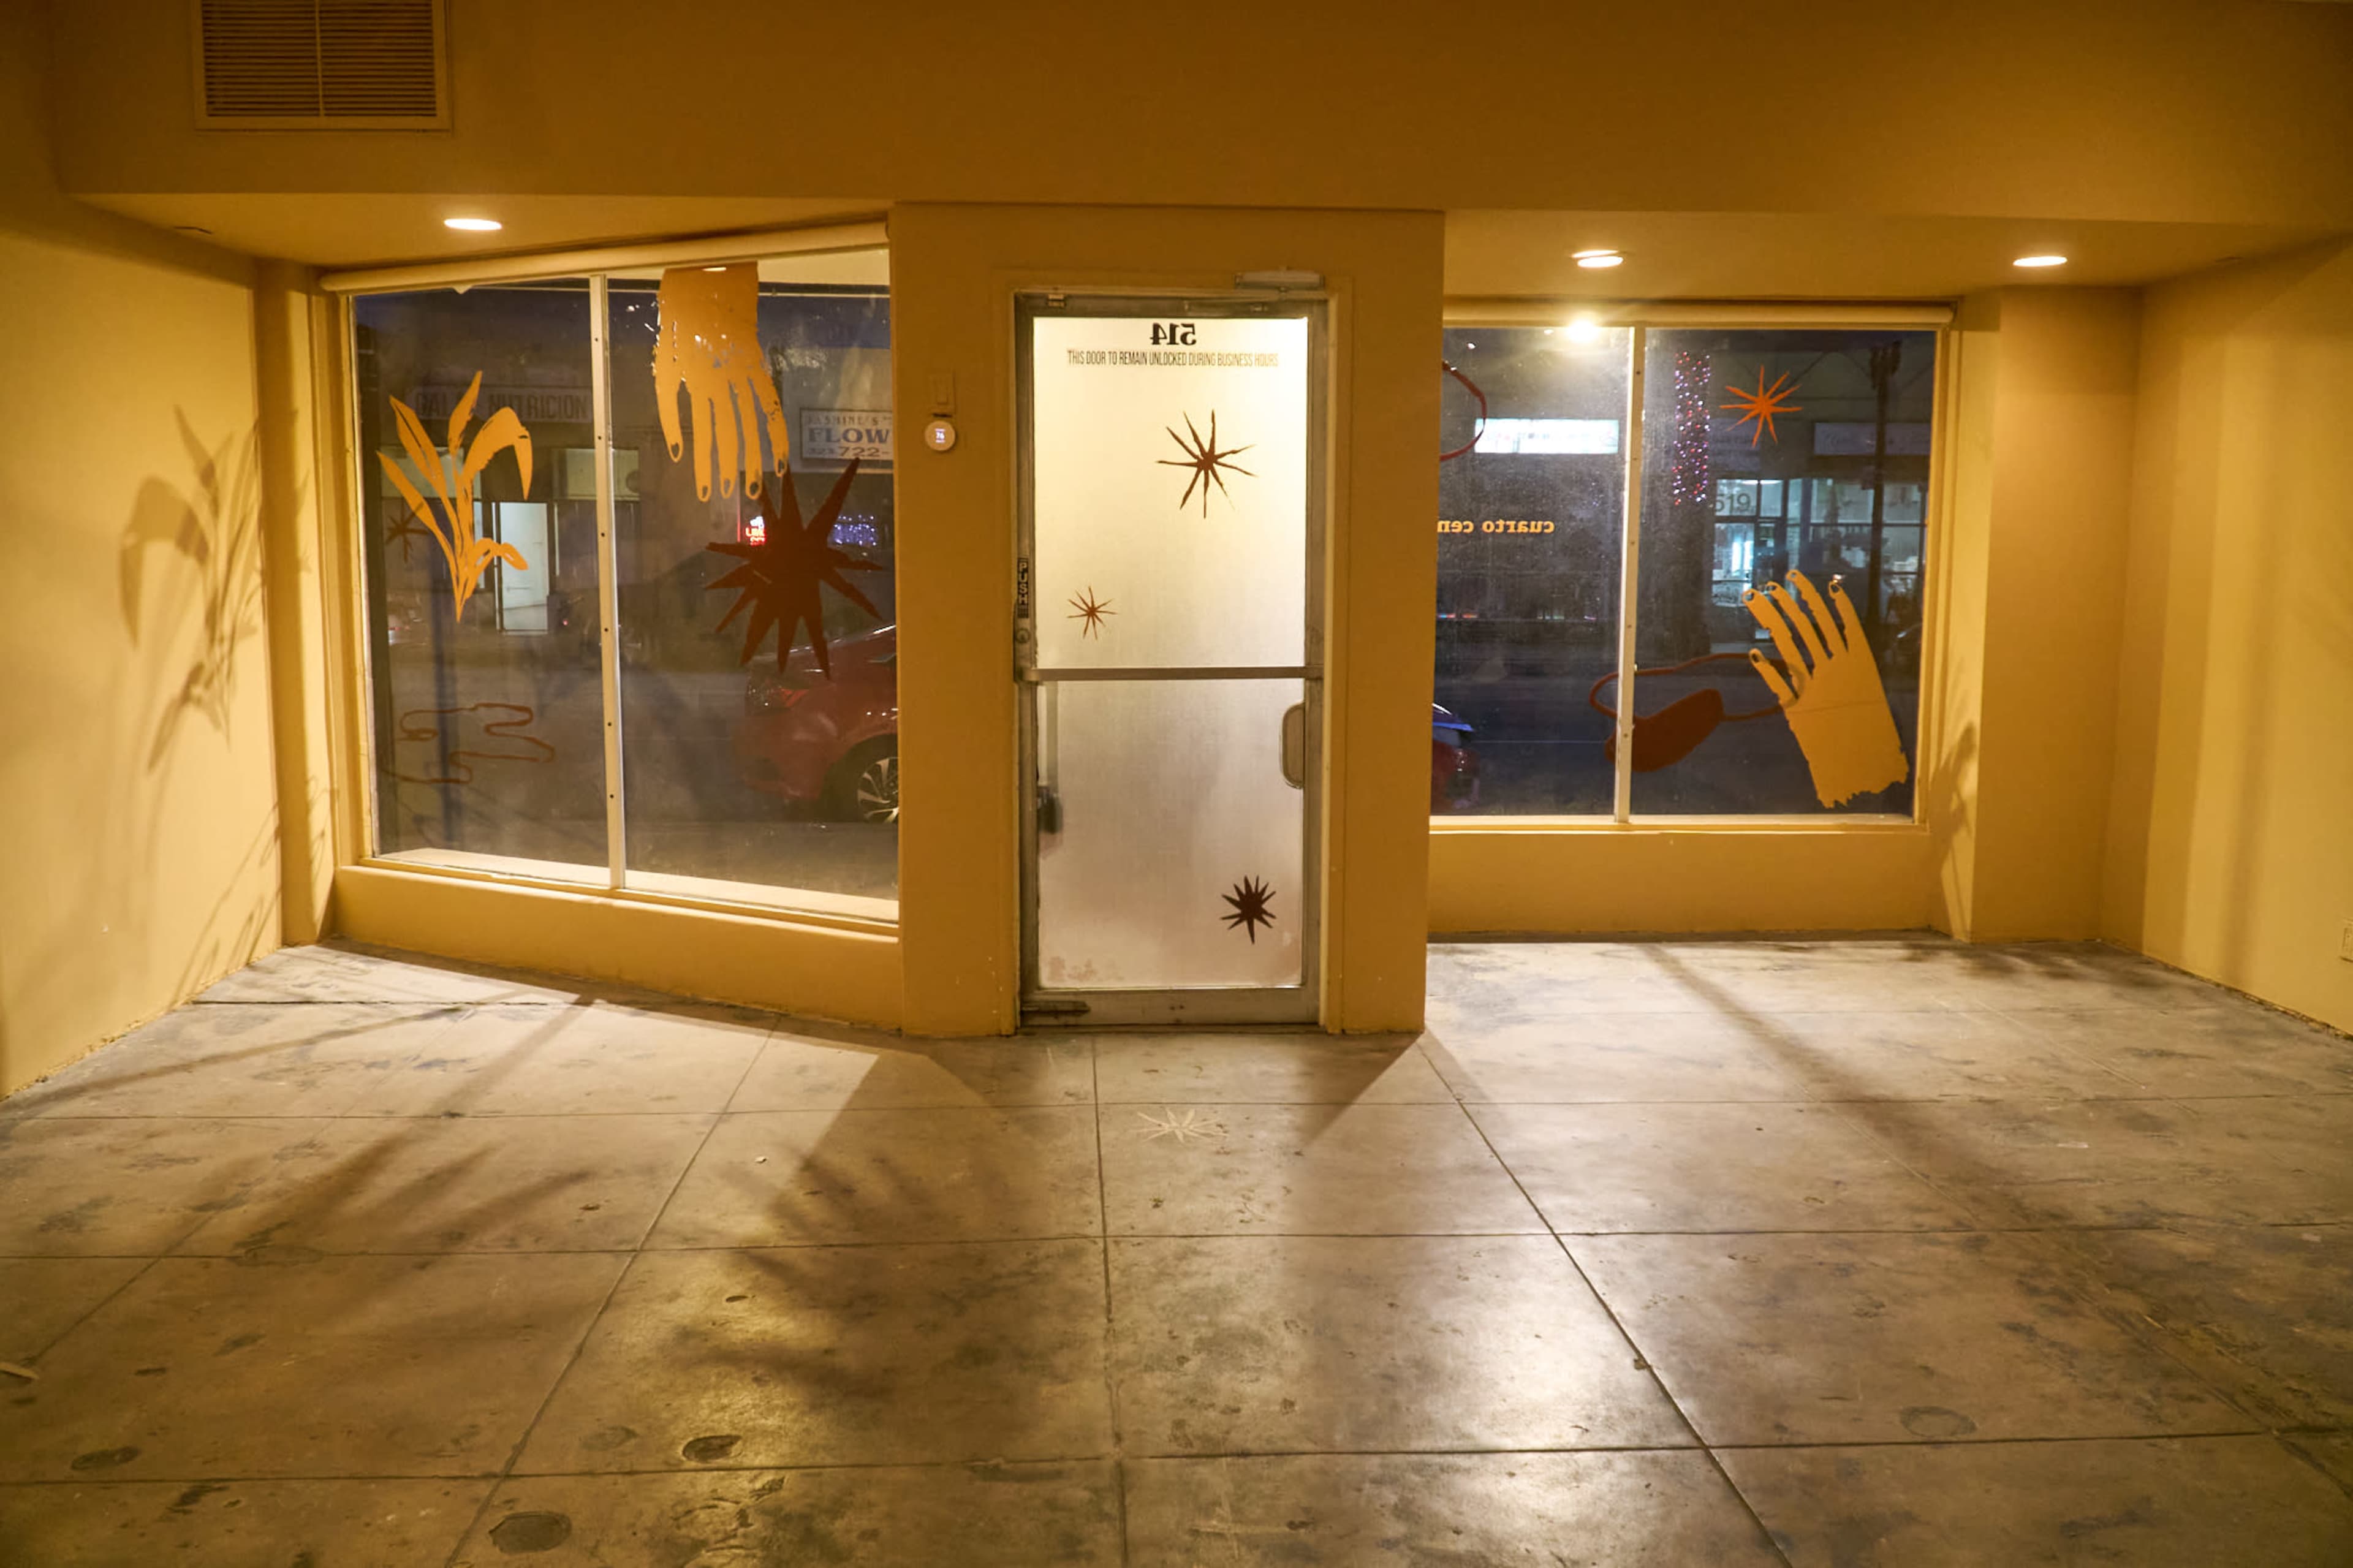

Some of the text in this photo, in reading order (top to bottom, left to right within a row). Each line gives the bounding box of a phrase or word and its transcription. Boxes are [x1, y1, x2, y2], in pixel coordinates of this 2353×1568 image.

[1067, 350, 1279, 367] THIS DOOR TO REMAIN UNLOCKED DURING BUSINESS HOURS
[1018, 562, 1028, 605] PUSH
